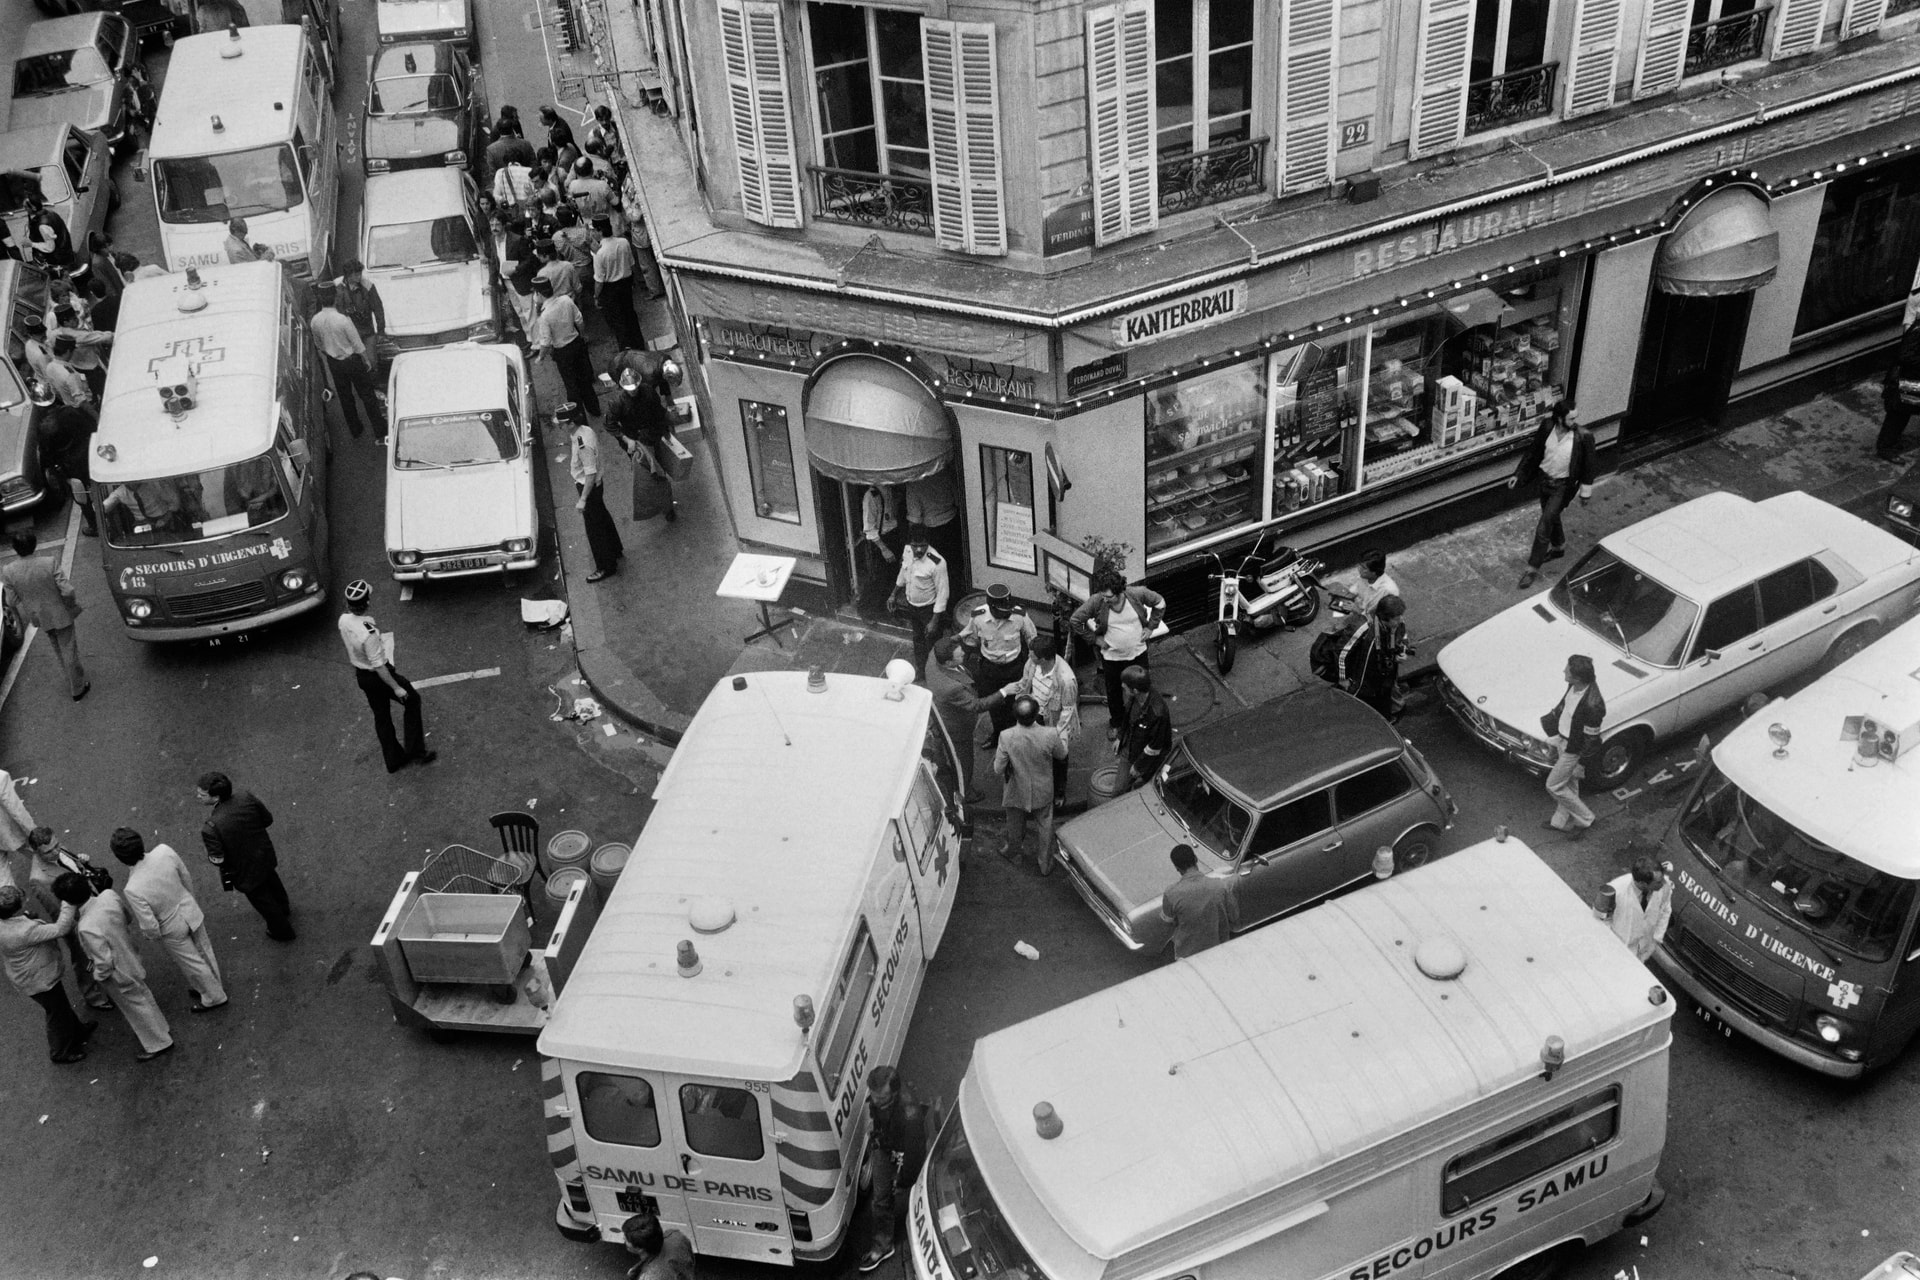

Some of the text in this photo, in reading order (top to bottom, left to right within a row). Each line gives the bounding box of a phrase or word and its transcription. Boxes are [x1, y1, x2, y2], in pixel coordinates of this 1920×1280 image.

[1345, 123, 1365, 144] 22
[1081, 209, 1094, 222] RU
[1353, 192, 1567, 277] RESTAURANT
[178, 241, 300, 268] SAMU RIS
[1126, 288, 1235, 343] KANTERBRÄU
[721, 328, 809, 358] CHARCUTERIE
[946, 366, 1035, 399] RESTAURANT
[1073, 363, 1123, 386] FERDINAND DUVAL
[135, 543, 270, 576] SECOURS D'URGENCE
[130, 576, 147, 588] 18
[209, 634, 249, 647] AR 21
[1678, 870, 1740, 927] SECOURS
[1744, 923, 1836, 982] D'URGENCE
[833, 1037, 869, 1139] POLICE
[871, 913, 909, 1029] SECOURS
[1695, 1006, 1732, 1037] AR 19
[744, 1081, 770, 1093] 955
[586, 1165, 774, 1202] SAMU DE PARIS
[1350, 1154, 1609, 1280] SECOURS SAMU
[914, 1196, 941, 1275] SAMU
